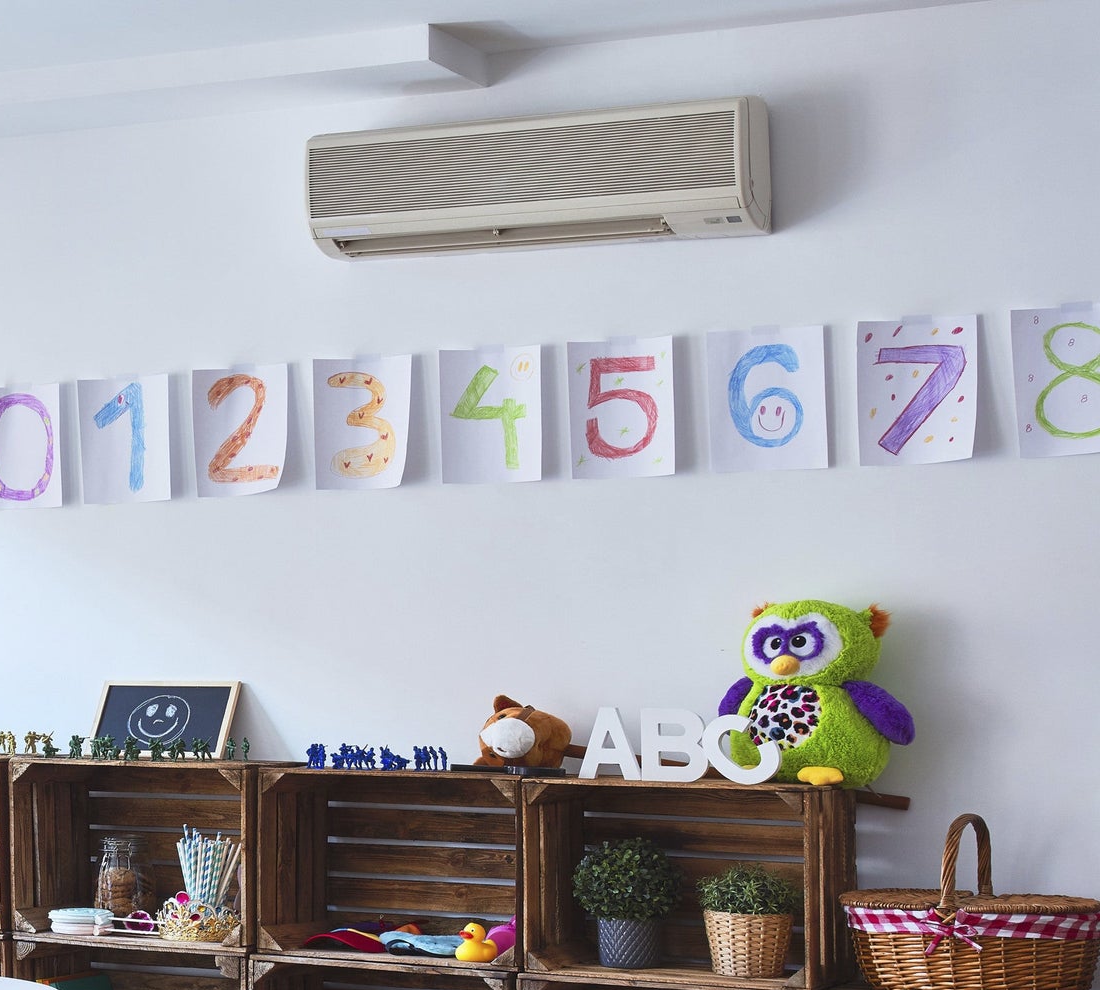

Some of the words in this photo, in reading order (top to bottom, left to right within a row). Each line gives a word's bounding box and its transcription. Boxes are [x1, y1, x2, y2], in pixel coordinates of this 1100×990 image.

[92, 381, 145, 492] 1
[207, 373, 280, 483] 2
[327, 371, 395, 479] 3
[449, 364, 527, 470] 4
[586, 355, 660, 460] 5
[727, 343, 804, 448] 6
[873, 344, 967, 456] 7
[1034, 321, 1100, 439] 8
[578, 706, 783, 785] ABC
